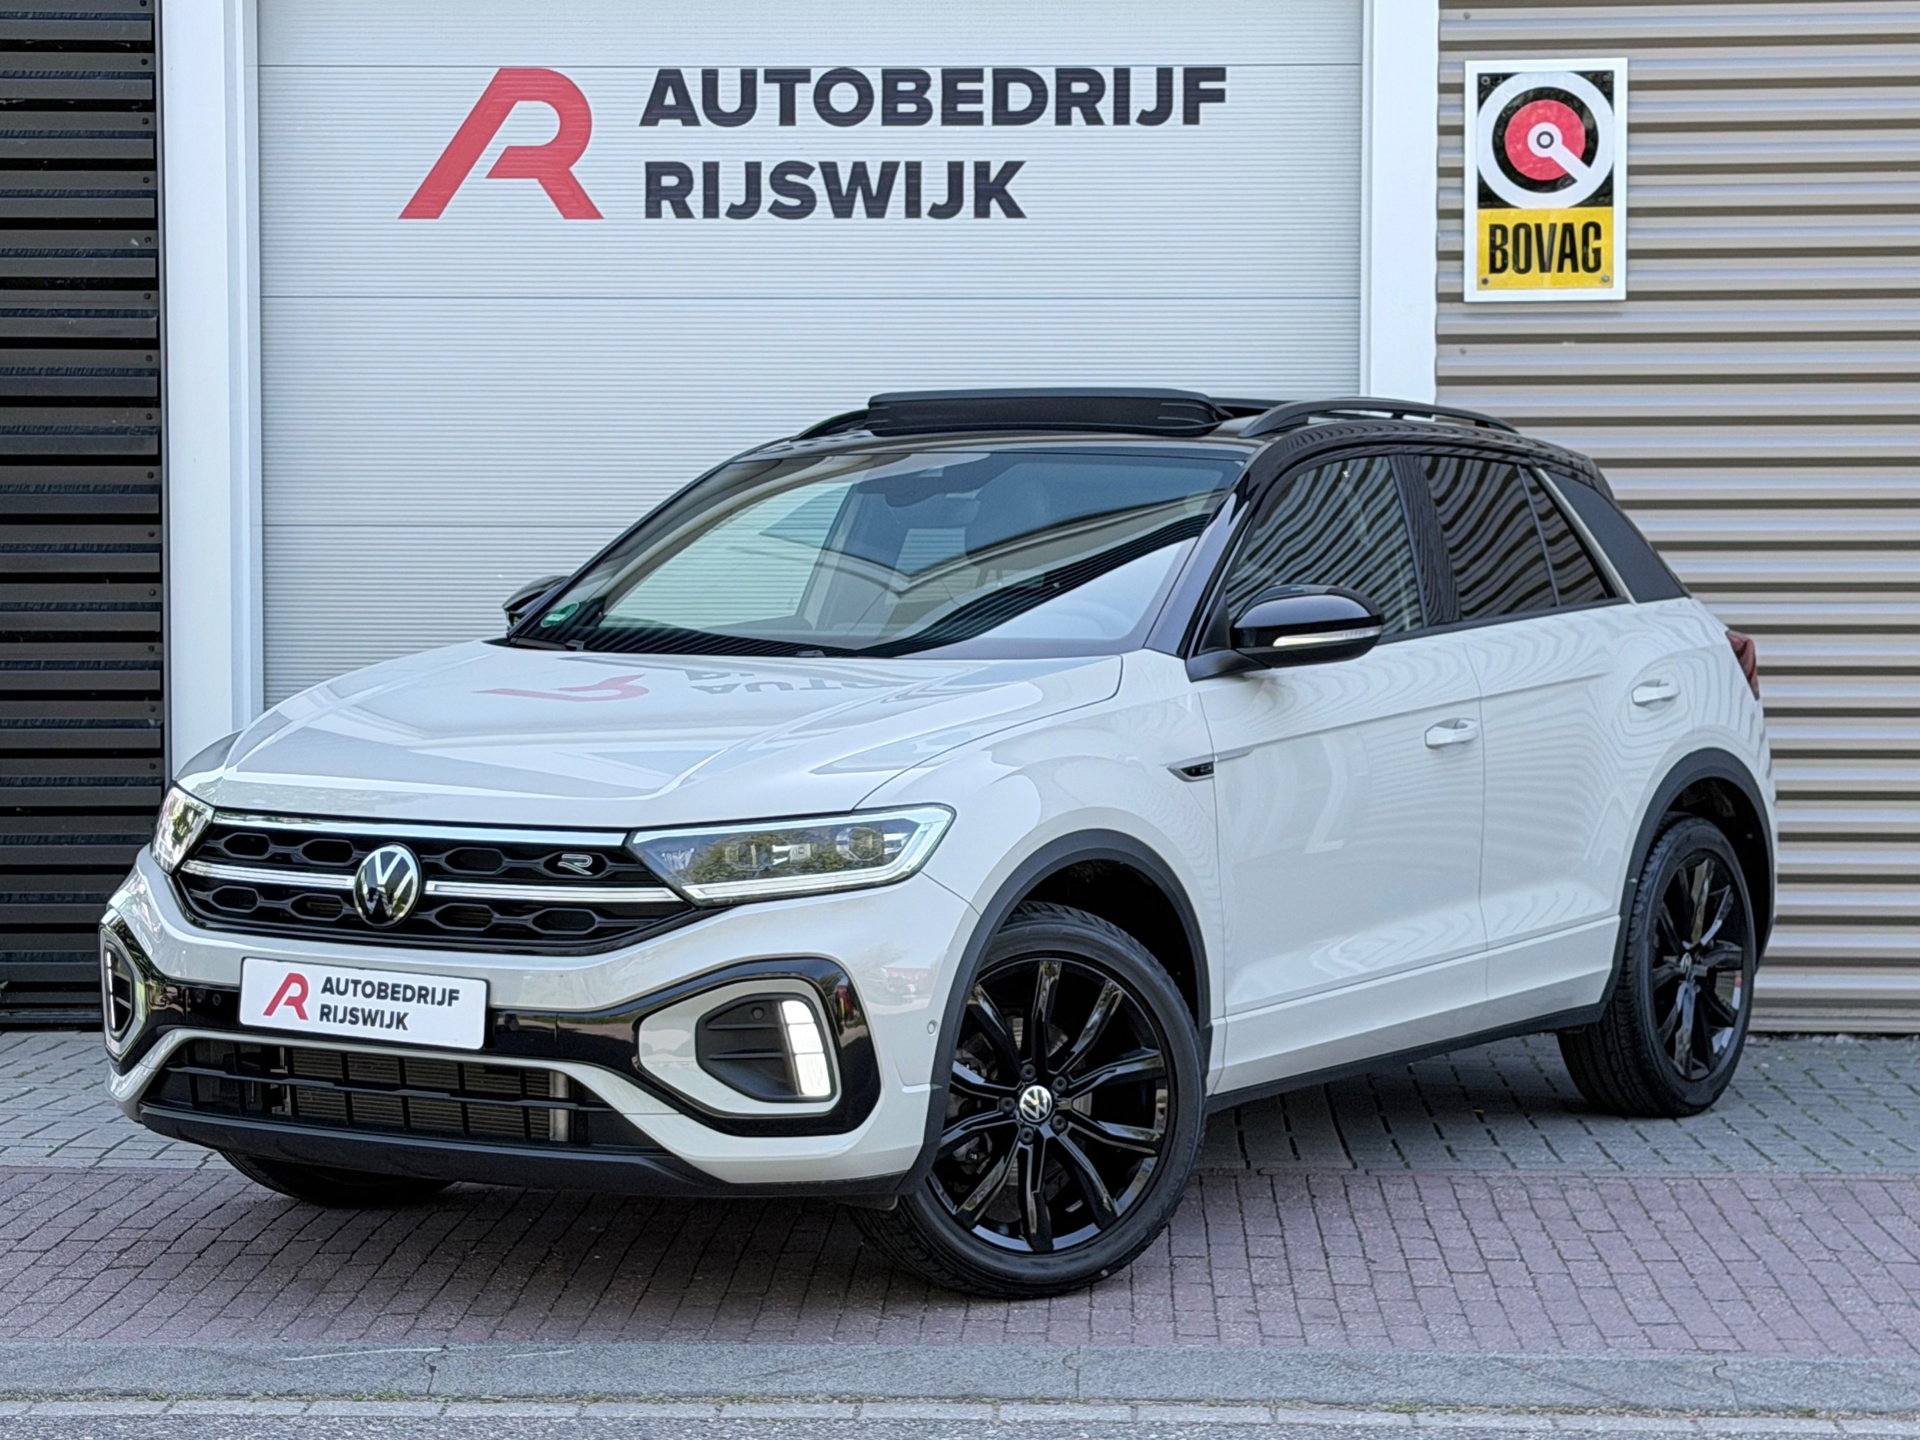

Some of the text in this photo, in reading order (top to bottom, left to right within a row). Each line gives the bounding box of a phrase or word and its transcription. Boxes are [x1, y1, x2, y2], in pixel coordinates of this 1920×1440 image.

[639, 67, 1226, 127] AUTOBEDRIJF
[644, 160, 1027, 221] RIJSWIJK
[1488, 221, 1602, 275] BOVAG
[318, 1003, 409, 1031] RIJSWIJK
[320, 976, 460, 1008] AUTOBEDRIJF
